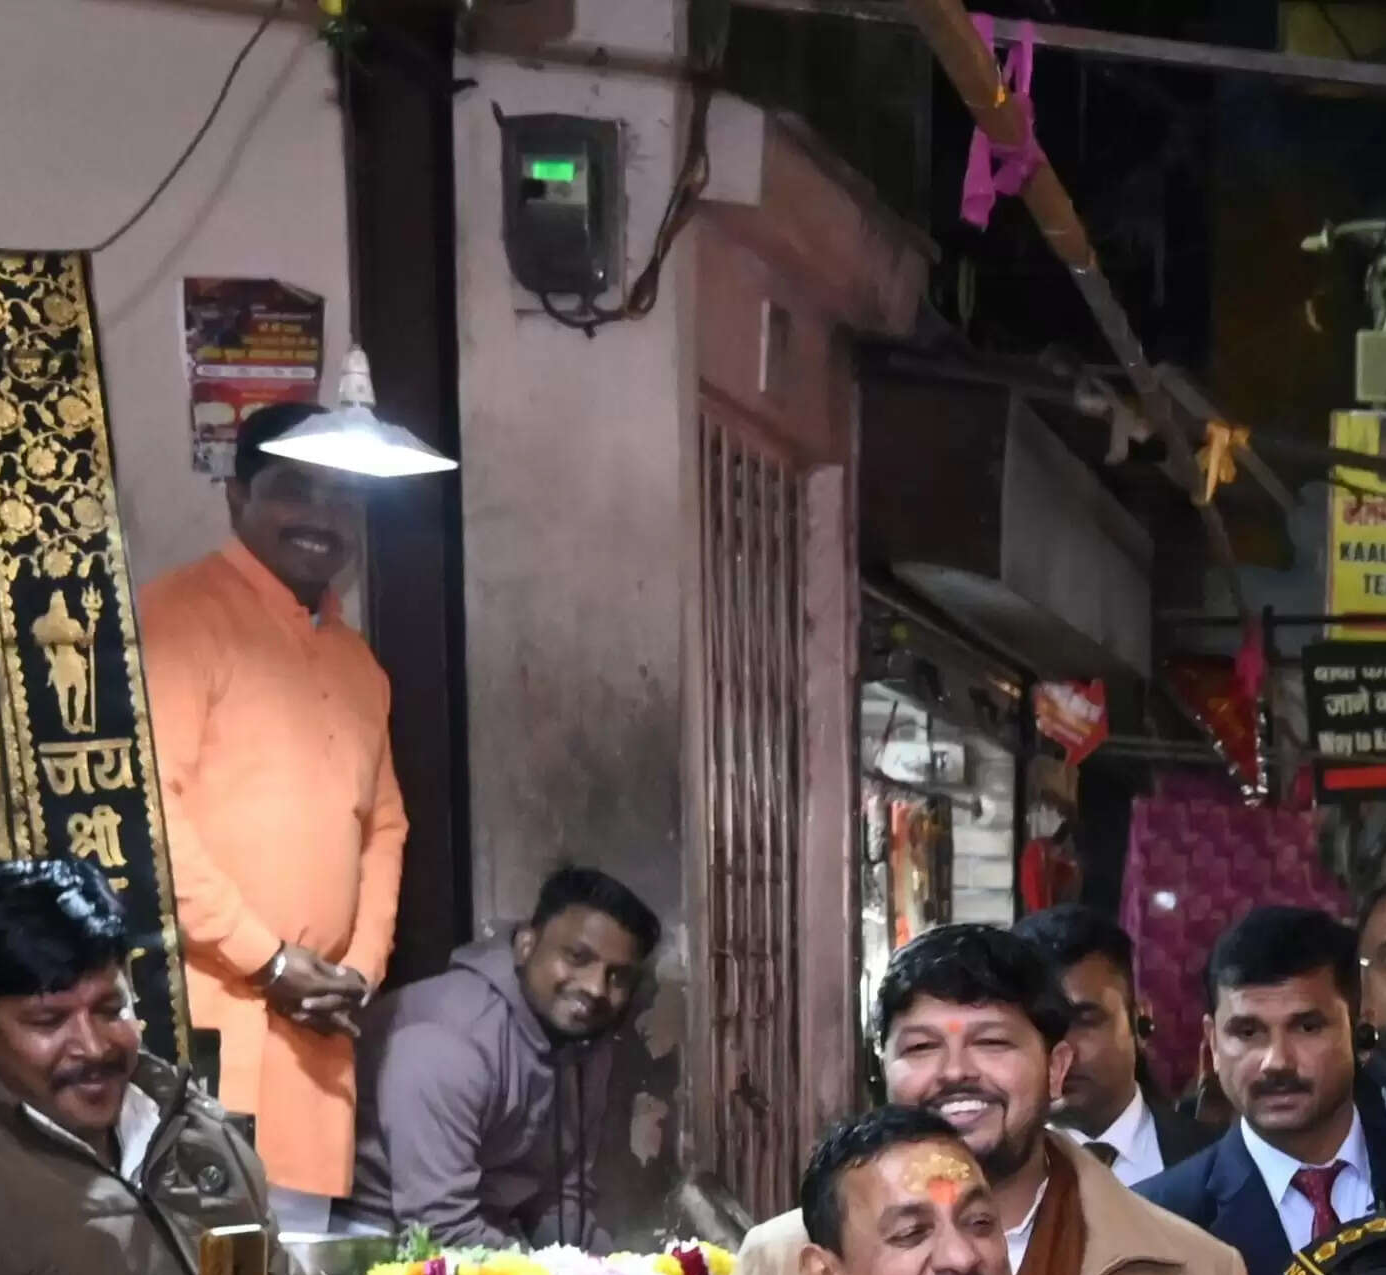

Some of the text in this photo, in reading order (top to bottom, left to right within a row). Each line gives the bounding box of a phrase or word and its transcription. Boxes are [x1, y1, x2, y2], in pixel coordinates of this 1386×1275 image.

[1324, 685, 1370, 717] जाने
[1355, 731, 1373, 753] to
[38, 737, 137, 796] जय
[67, 804, 128, 868] श्री
